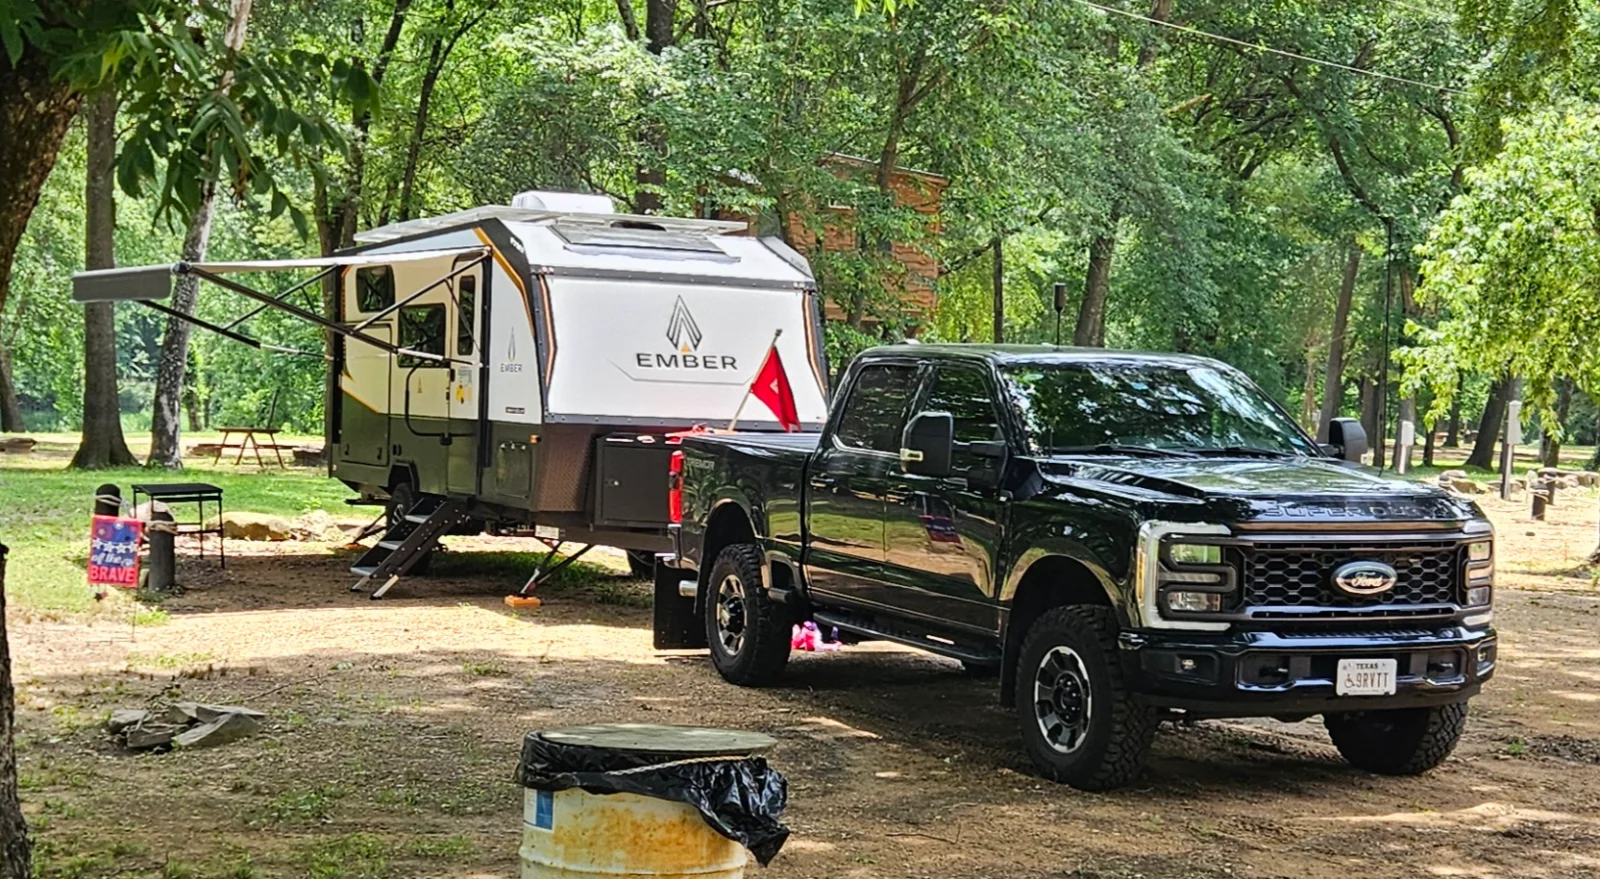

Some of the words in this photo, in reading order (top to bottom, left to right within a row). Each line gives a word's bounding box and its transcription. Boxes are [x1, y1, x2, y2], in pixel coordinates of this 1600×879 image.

[500, 363, 522, 372] EMBER
[636, 353, 738, 370] EMBER
[1264, 503, 1366, 517] SUPER
[90, 565, 135, 582] BRAVE
[1351, 571, 1383, 587] Ford
[1356, 672, 1388, 688] 9RVTT
